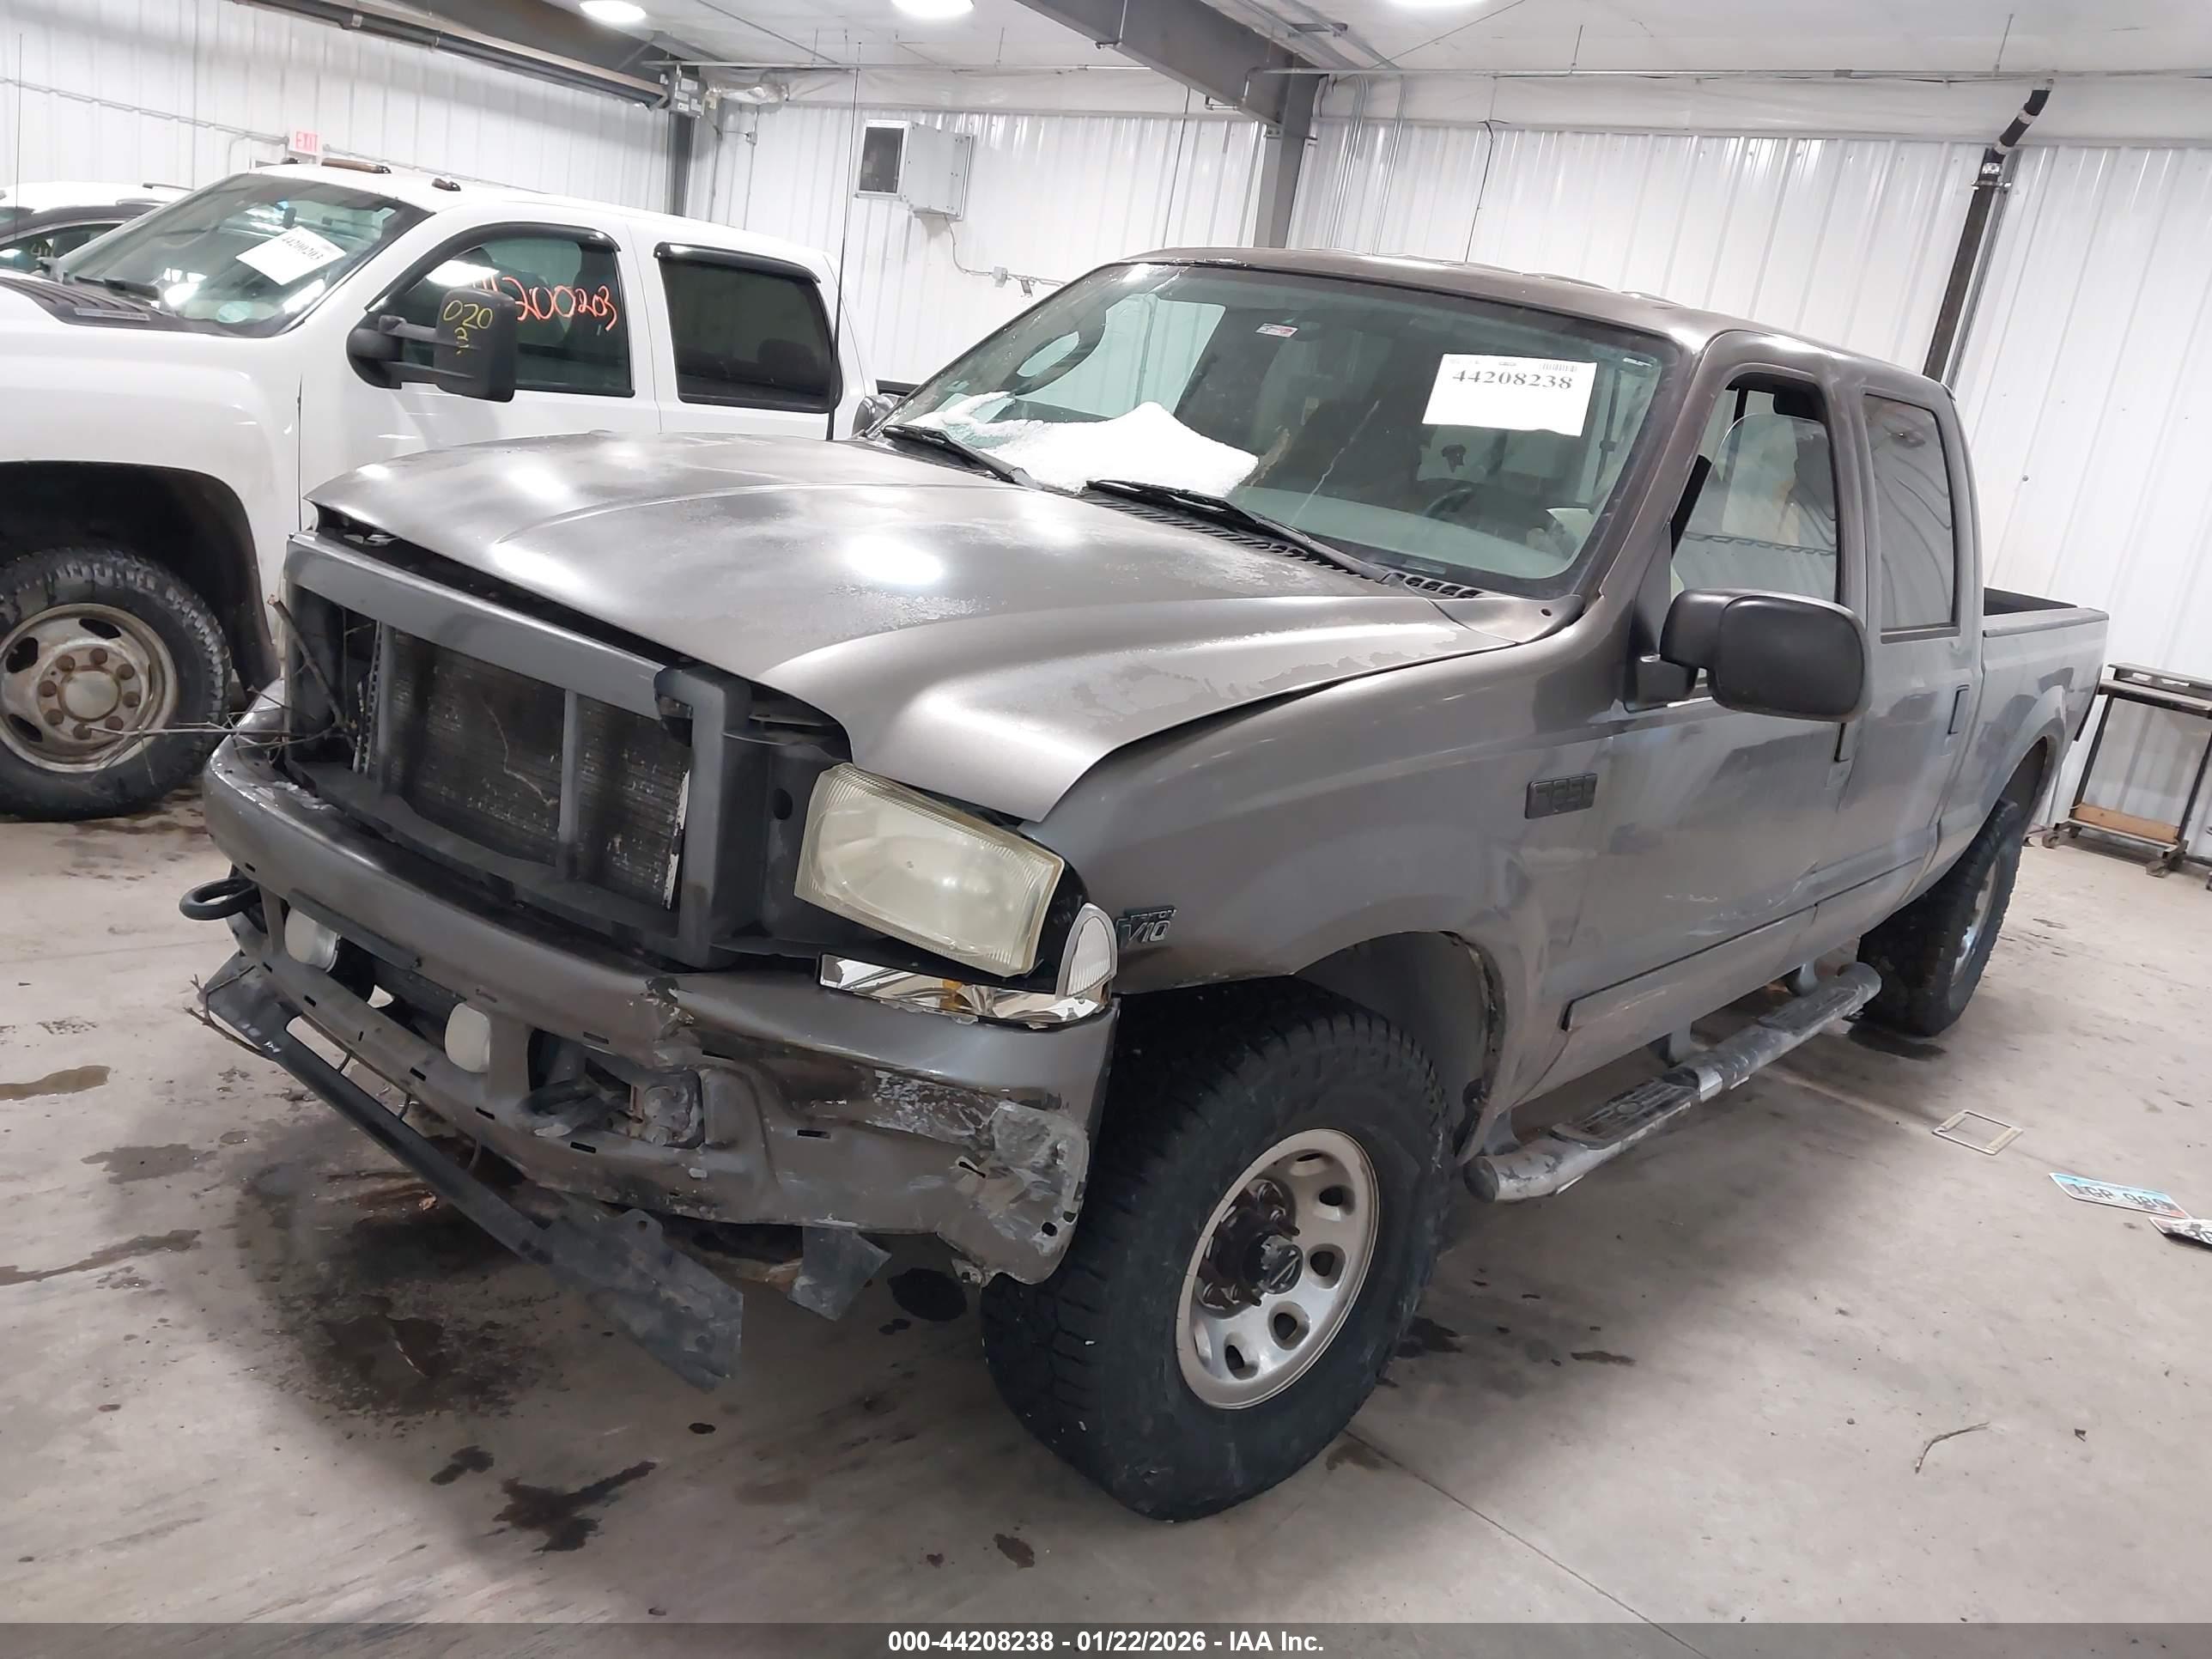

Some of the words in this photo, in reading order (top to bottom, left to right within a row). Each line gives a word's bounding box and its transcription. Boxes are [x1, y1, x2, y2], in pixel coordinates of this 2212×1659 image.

[443, 300, 493, 330] 020
[1452, 370, 1573, 389] 44208238
[1115, 918, 1171, 944] V10
